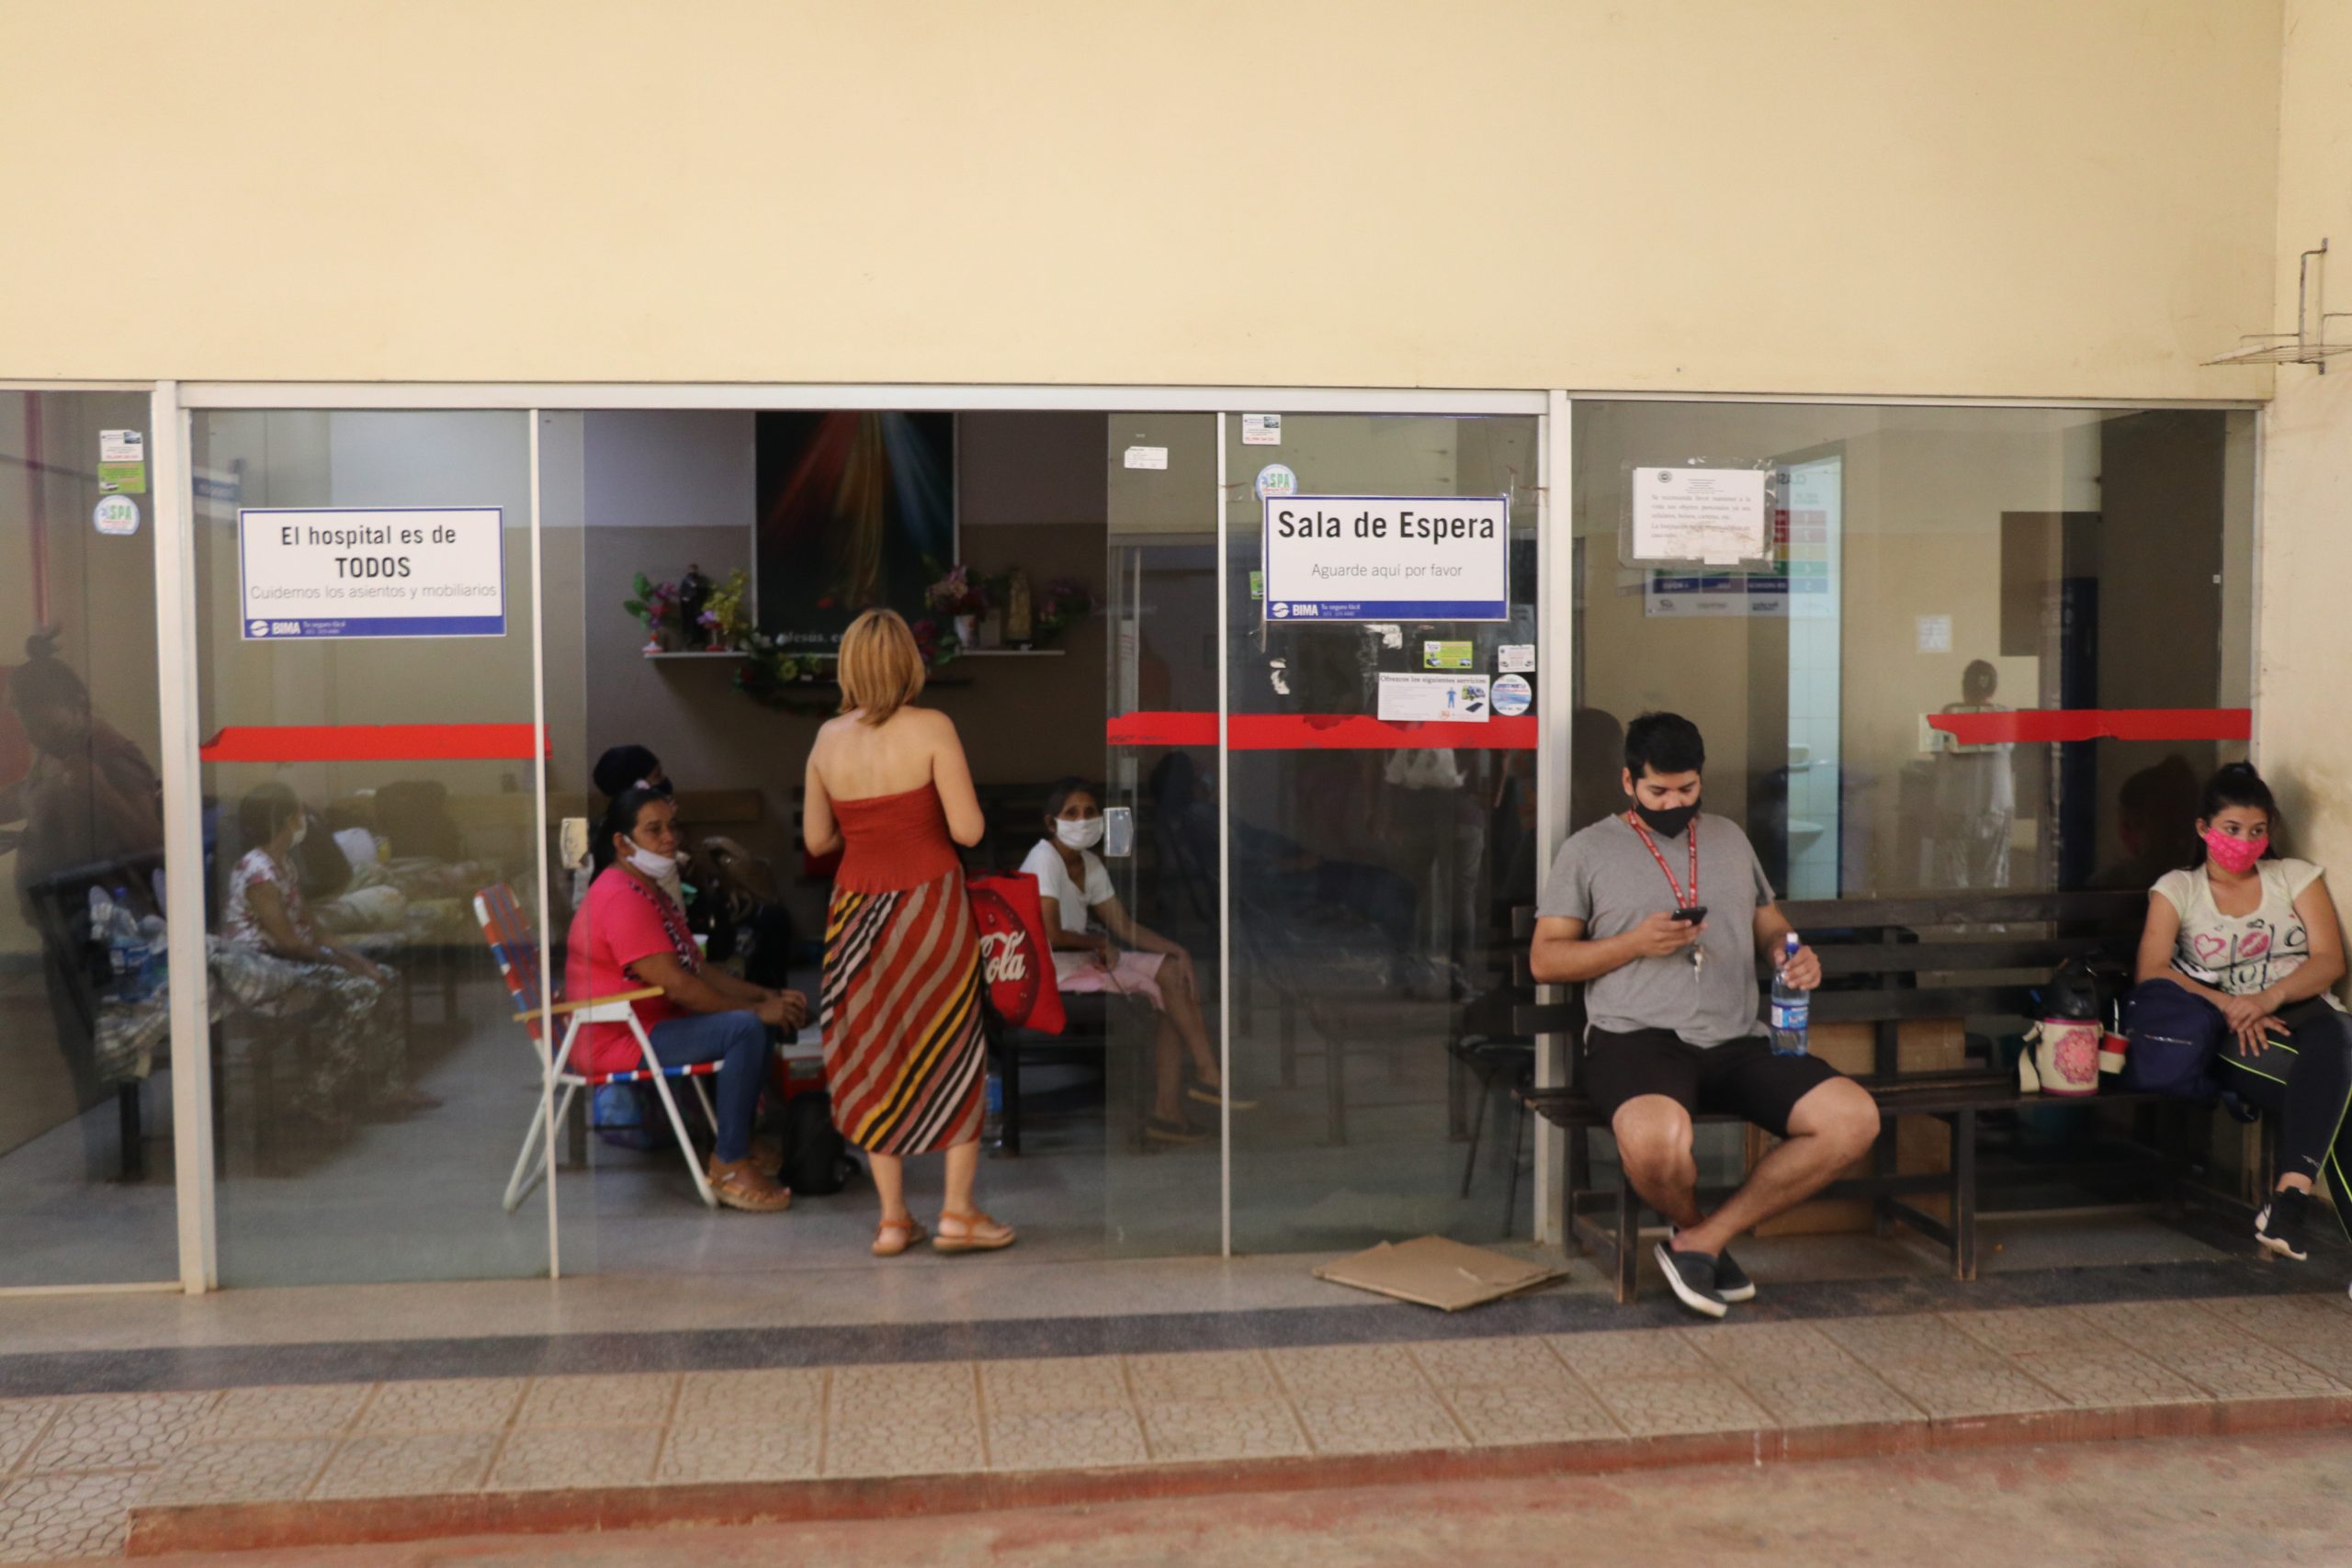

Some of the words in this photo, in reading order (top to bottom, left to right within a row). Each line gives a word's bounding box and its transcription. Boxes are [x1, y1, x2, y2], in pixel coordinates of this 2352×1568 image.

[281, 526, 300, 546] El
[309, 525, 391, 548] hospital
[401, 529, 424, 544] es
[432, 525, 457, 544] de
[1278, 510, 1341, 538] Sala
[1354, 511, 1387, 538] de
[1400, 512, 1494, 545] Espera
[335, 557, 412, 579] TODOS
[1312, 563, 1367, 579] Aguarde
[1372, 564, 1401, 579] aquí
[1406, 566, 1427, 579] por
[1430, 564, 1462, 577] favor
[250, 585, 320, 600] Cuidemos
[325, 585, 345, 598] los
[348, 584, 406, 599] asientos
[410, 586, 418, 600] y
[422, 582, 497, 597] mobiliarios
[1292, 604, 1318, 616] BIMA
[272, 621, 301, 635] BIMA
